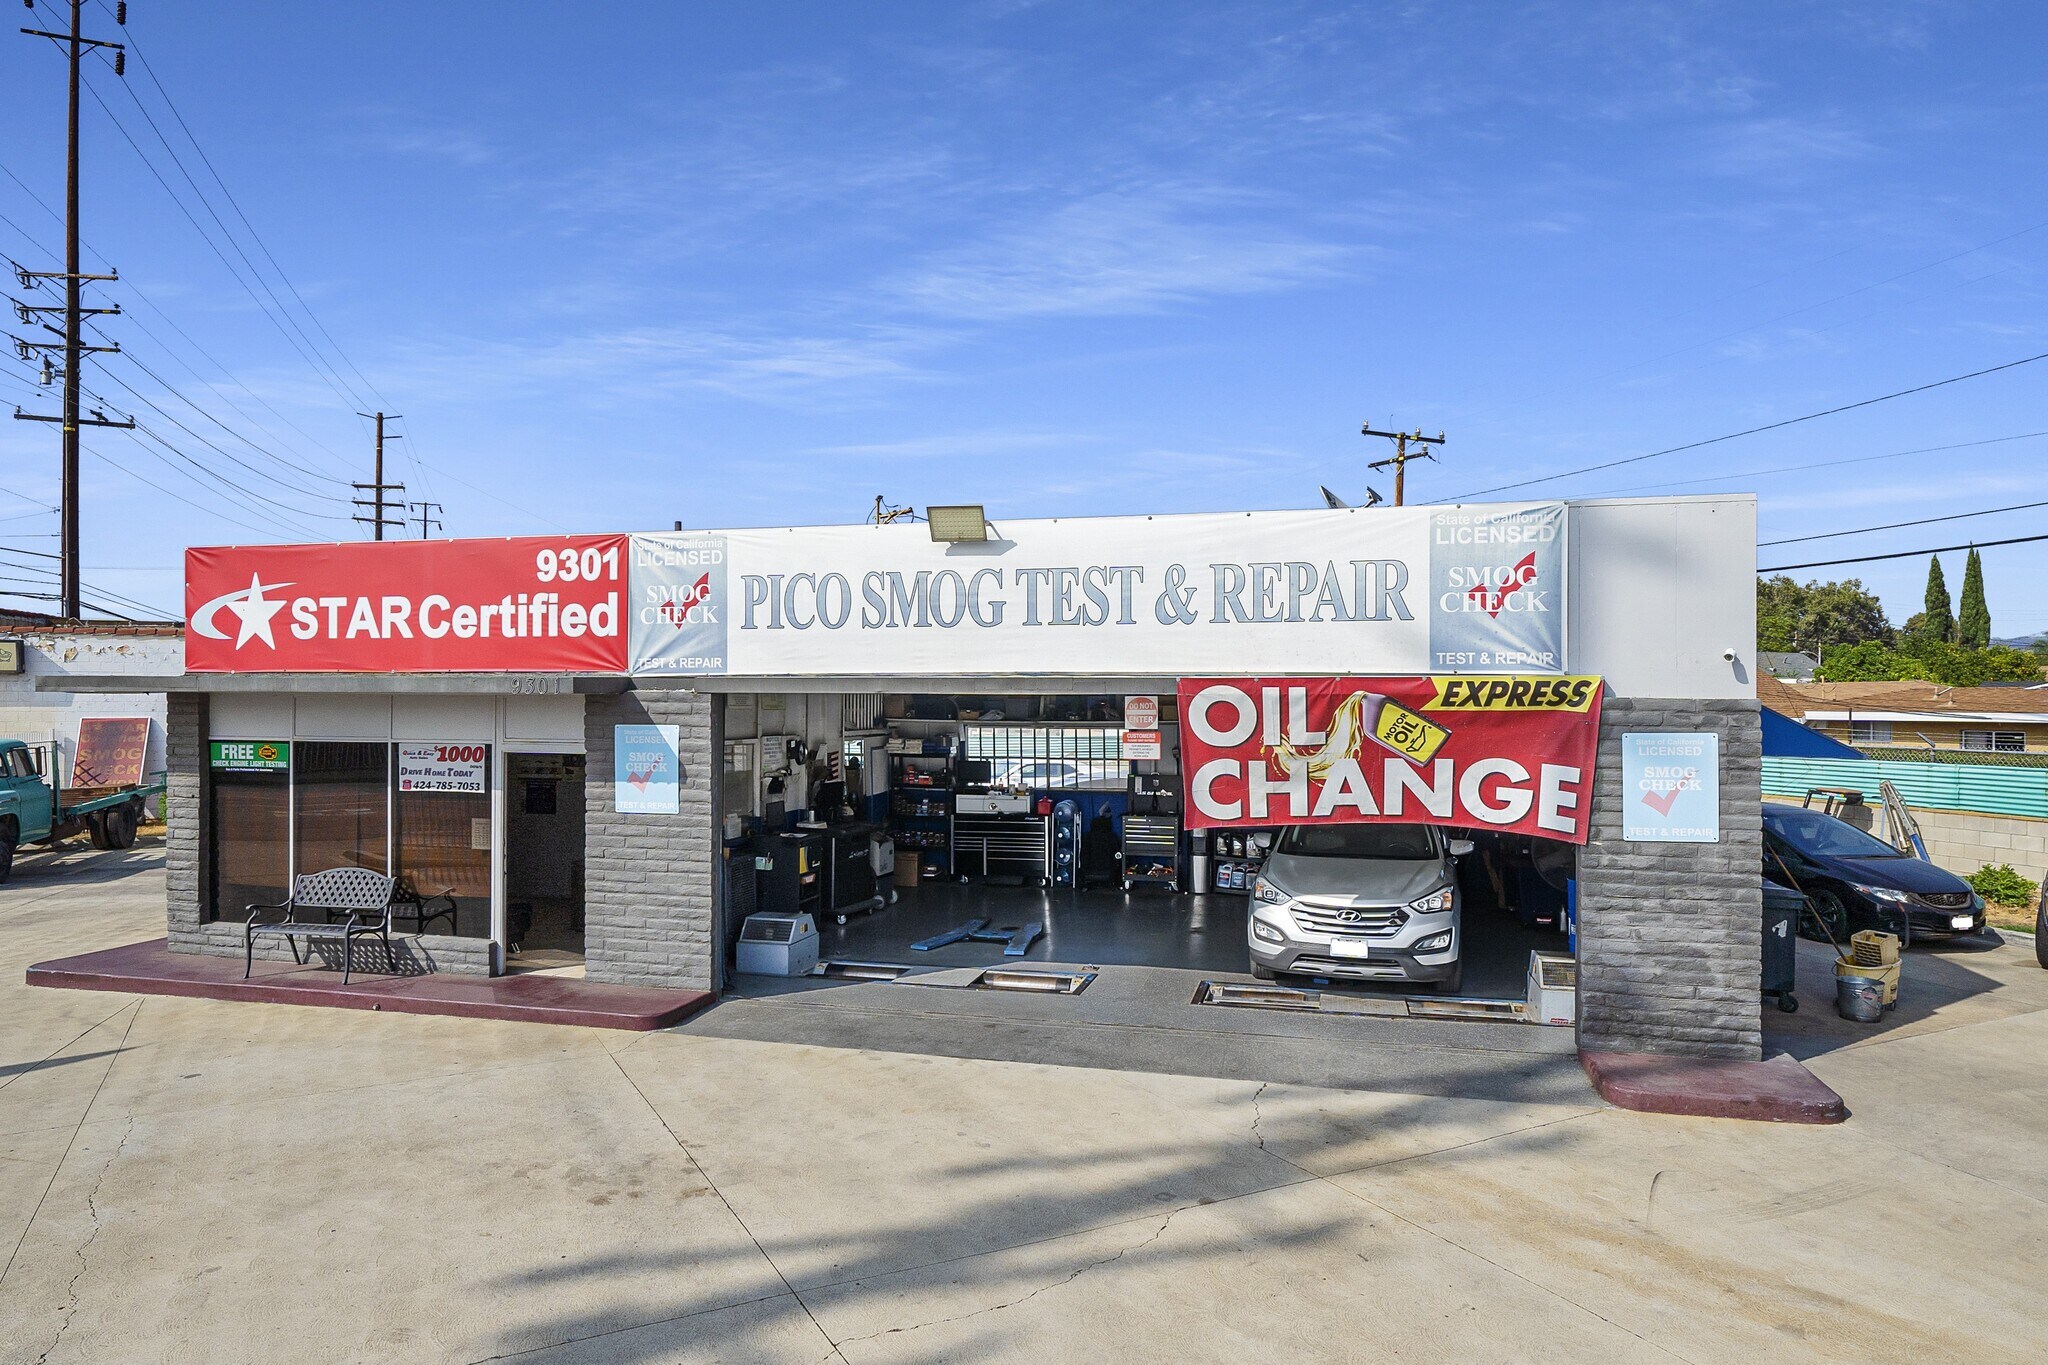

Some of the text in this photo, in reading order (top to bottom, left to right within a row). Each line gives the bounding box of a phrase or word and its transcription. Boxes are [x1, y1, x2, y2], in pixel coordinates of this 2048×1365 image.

[1436, 512, 1554, 525] State of California
[1436, 525, 1556, 545] LICENSED
[664, 540, 674, 550] of
[676, 538, 723, 549] California
[536, 546, 619, 582] 9301
[637, 549, 723, 567] LICENSED
[1448, 565, 1540, 588] SMOG
[646, 583, 712, 603] SMOG
[740, 559, 1416, 631] PICO SMOG TEST & REPAIR
[1439, 591, 1549, 613] CHECK
[290, 591, 619, 640] STAR Certified
[640, 605, 719, 625] CHECK
[638, 657, 723, 669] TEST & REPAIR
[1436, 652, 1555, 665] TEST & REPAIR
[510, 676, 561, 695] 9301
[1439, 680, 1594, 708] EXPRESS
[1129, 702, 1153, 710] DO NOT
[1129, 715, 1154, 723] ENTER
[1188, 684, 1327, 747] OIL
[1383, 712, 1409, 741] MOTOR
[1394, 721, 1420, 743] OIL
[221, 744, 254, 760] FREE
[433, 745, 485, 762] $1000
[629, 751, 664, 762] SMOG
[1638, 746, 1703, 756] LICENSED
[626, 762, 667, 772] CHECK
[1644, 766, 1697, 778] SMOG
[413, 781, 480, 791] 424-785-7053
[1639, 779, 1703, 791] CHECK
[1191, 757, 1582, 834] CHANGE
[620, 801, 676, 810] TEST & REPAIR
[1629, 827, 1714, 837] TEST & REPAIR
